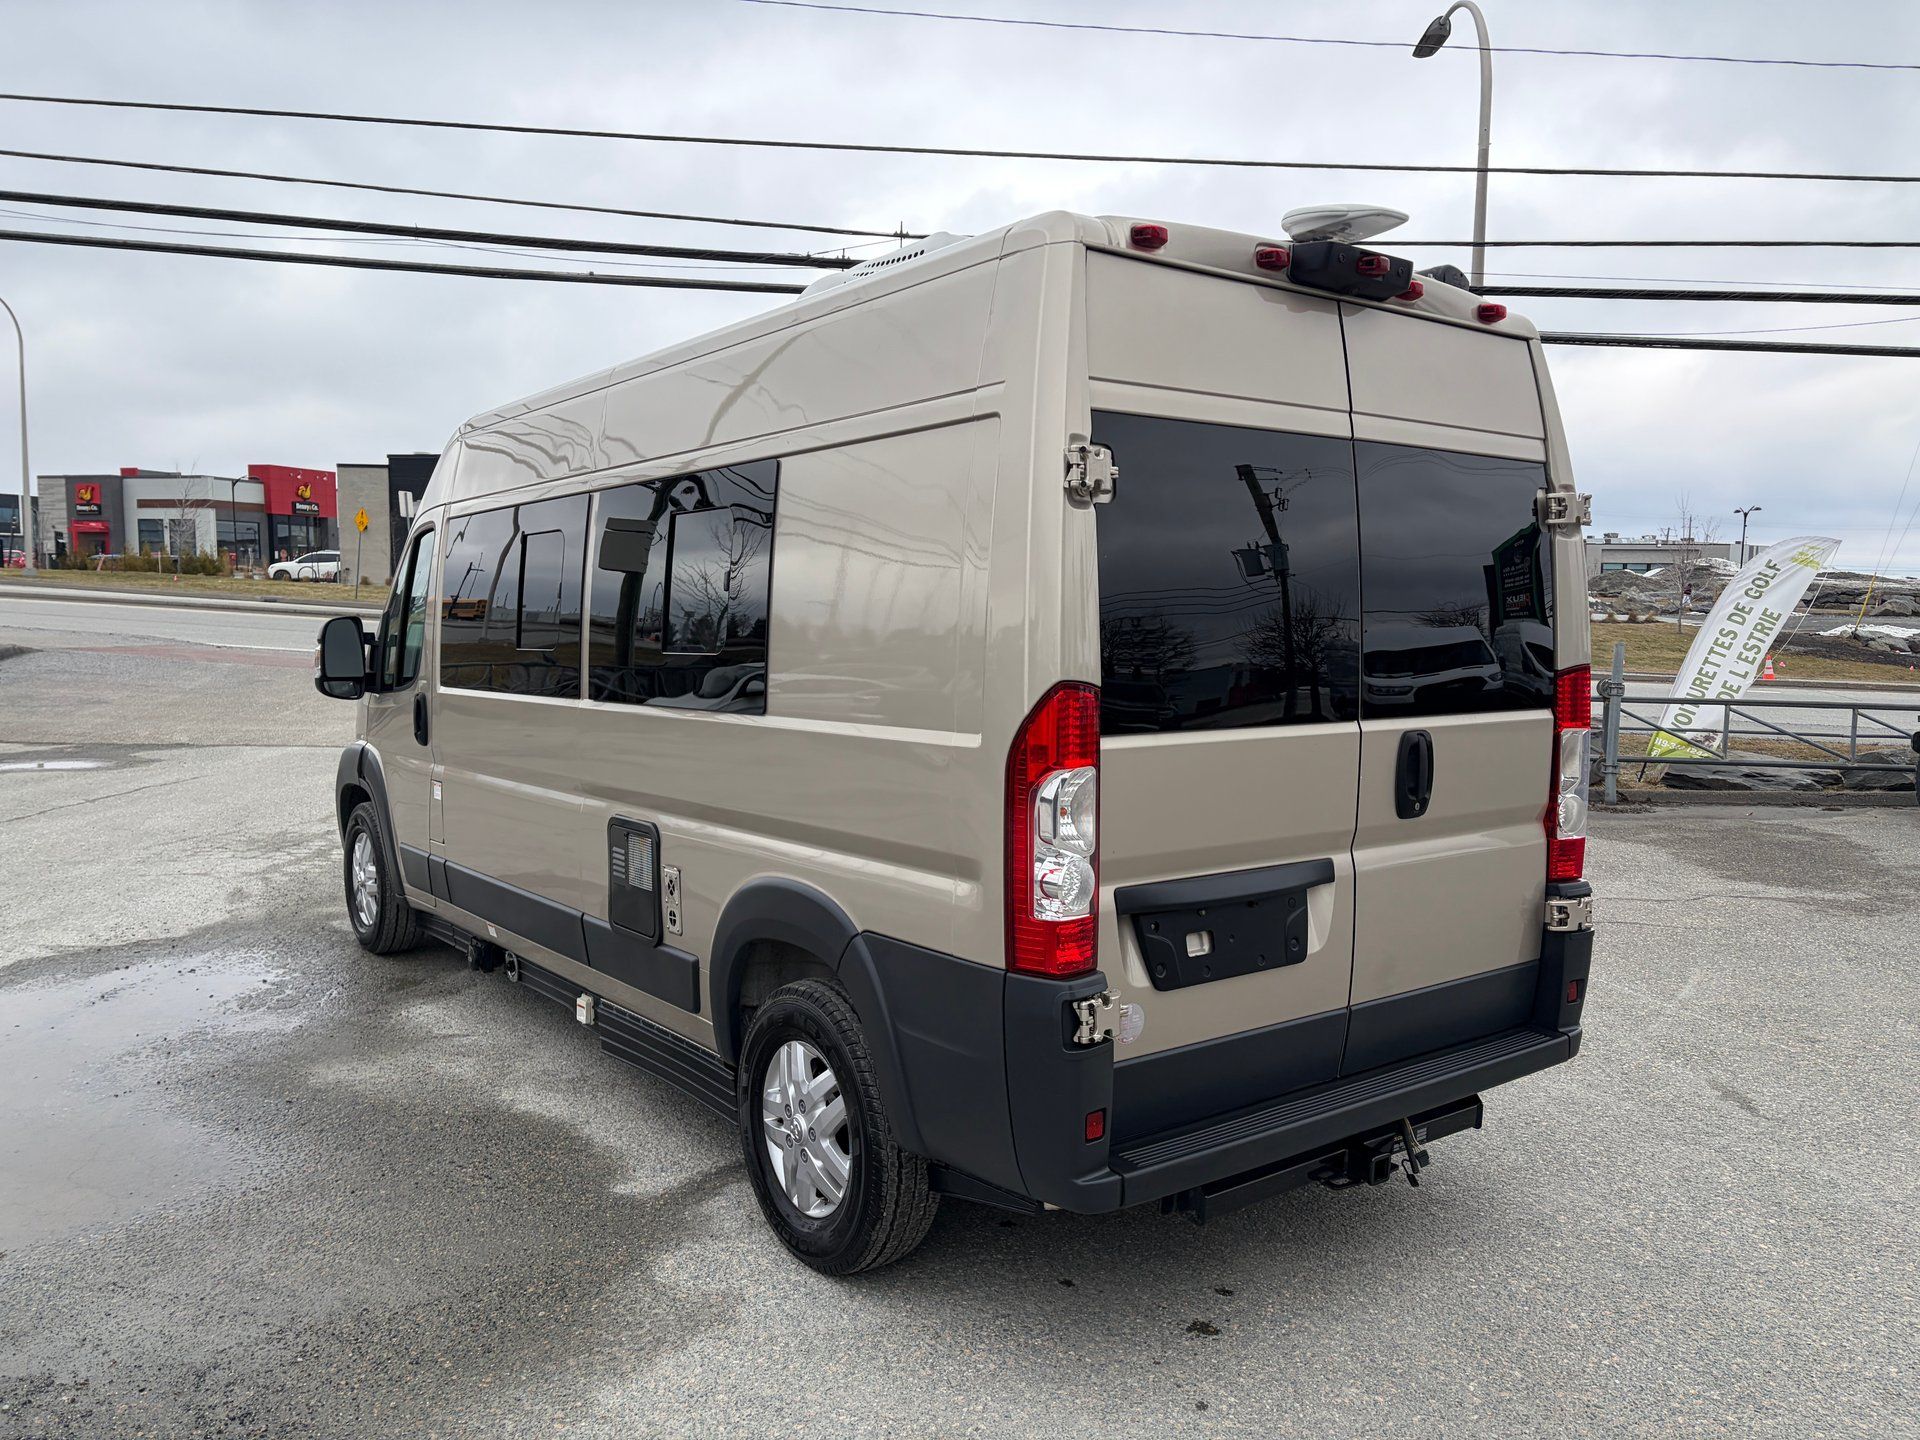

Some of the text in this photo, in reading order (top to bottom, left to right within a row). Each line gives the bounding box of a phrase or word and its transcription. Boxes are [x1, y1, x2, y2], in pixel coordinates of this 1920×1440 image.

[1726, 601, 1754, 626] DE
[1744, 558, 1782, 600] GOLF
[1715, 680, 1742, 700] DE
